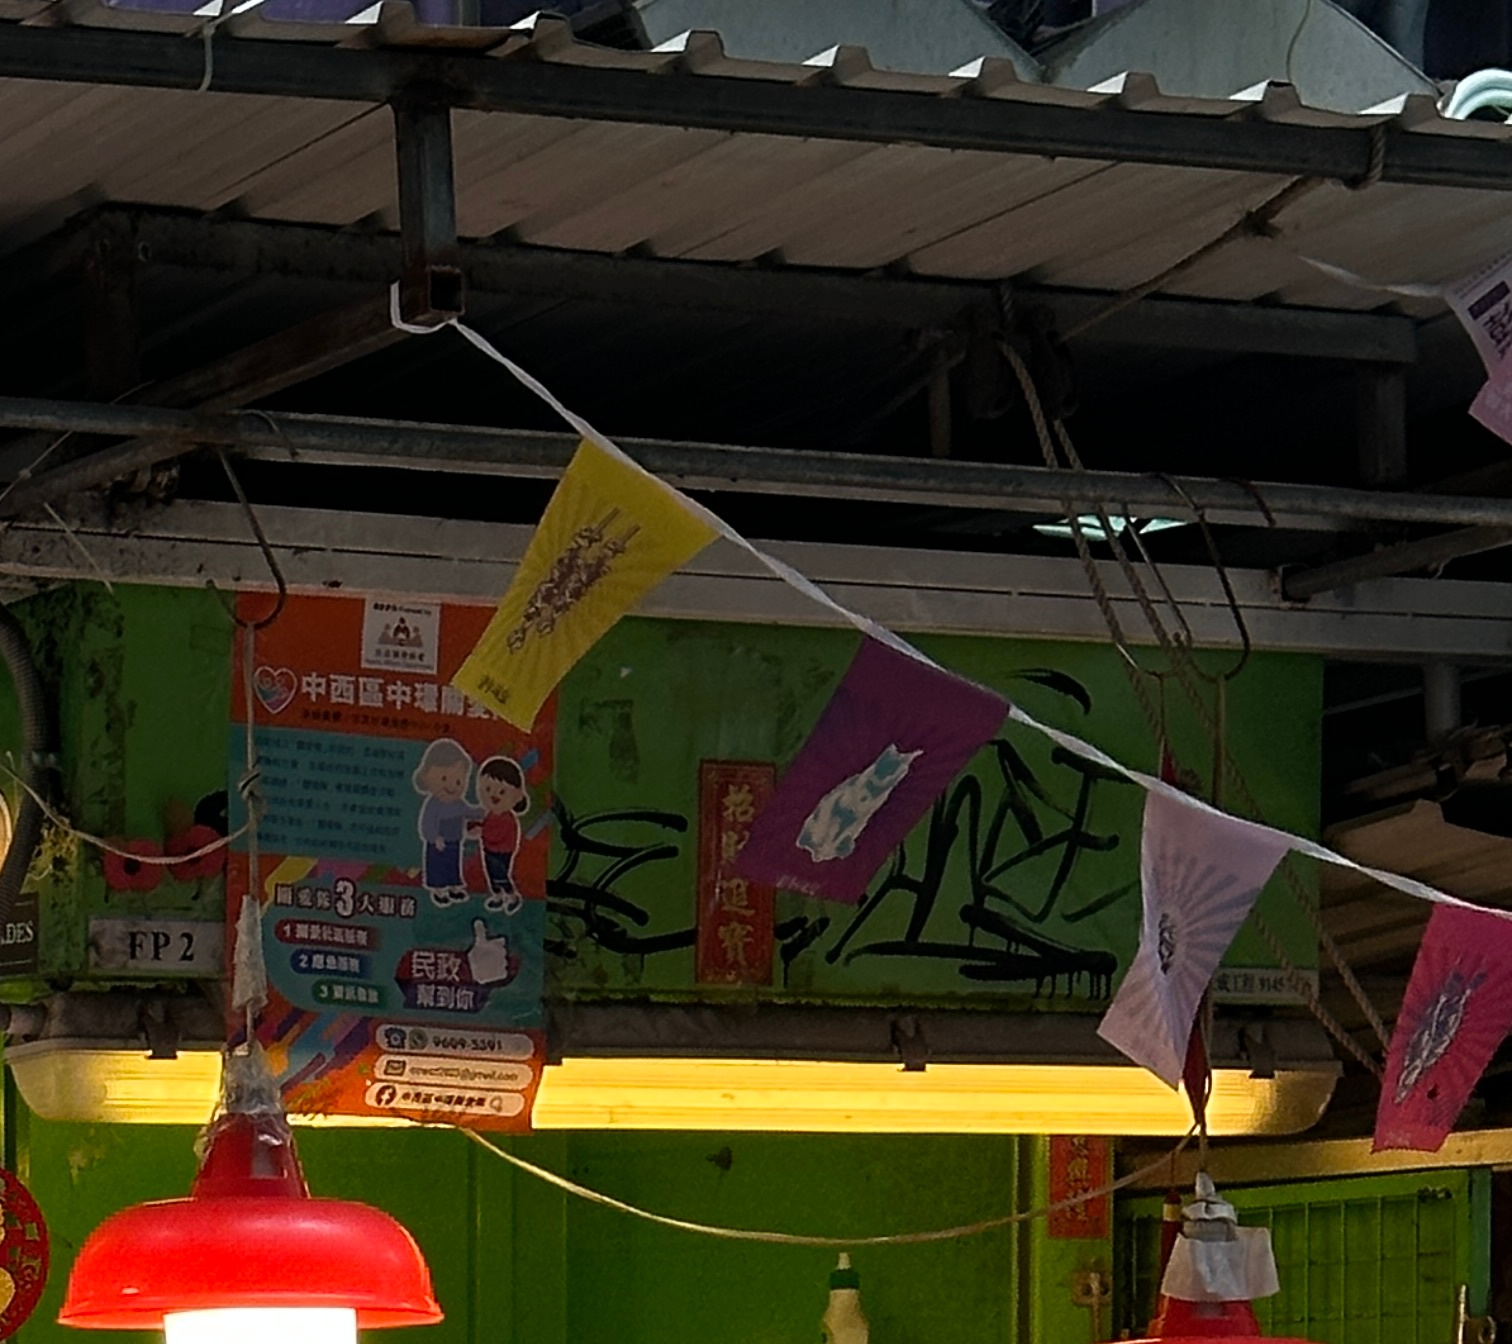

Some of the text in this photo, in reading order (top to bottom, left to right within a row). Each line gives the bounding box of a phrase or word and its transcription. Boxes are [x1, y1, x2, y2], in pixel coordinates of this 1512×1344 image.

[128, 930, 195, 962] FP 2
[411, 951, 464, 982] 民政
